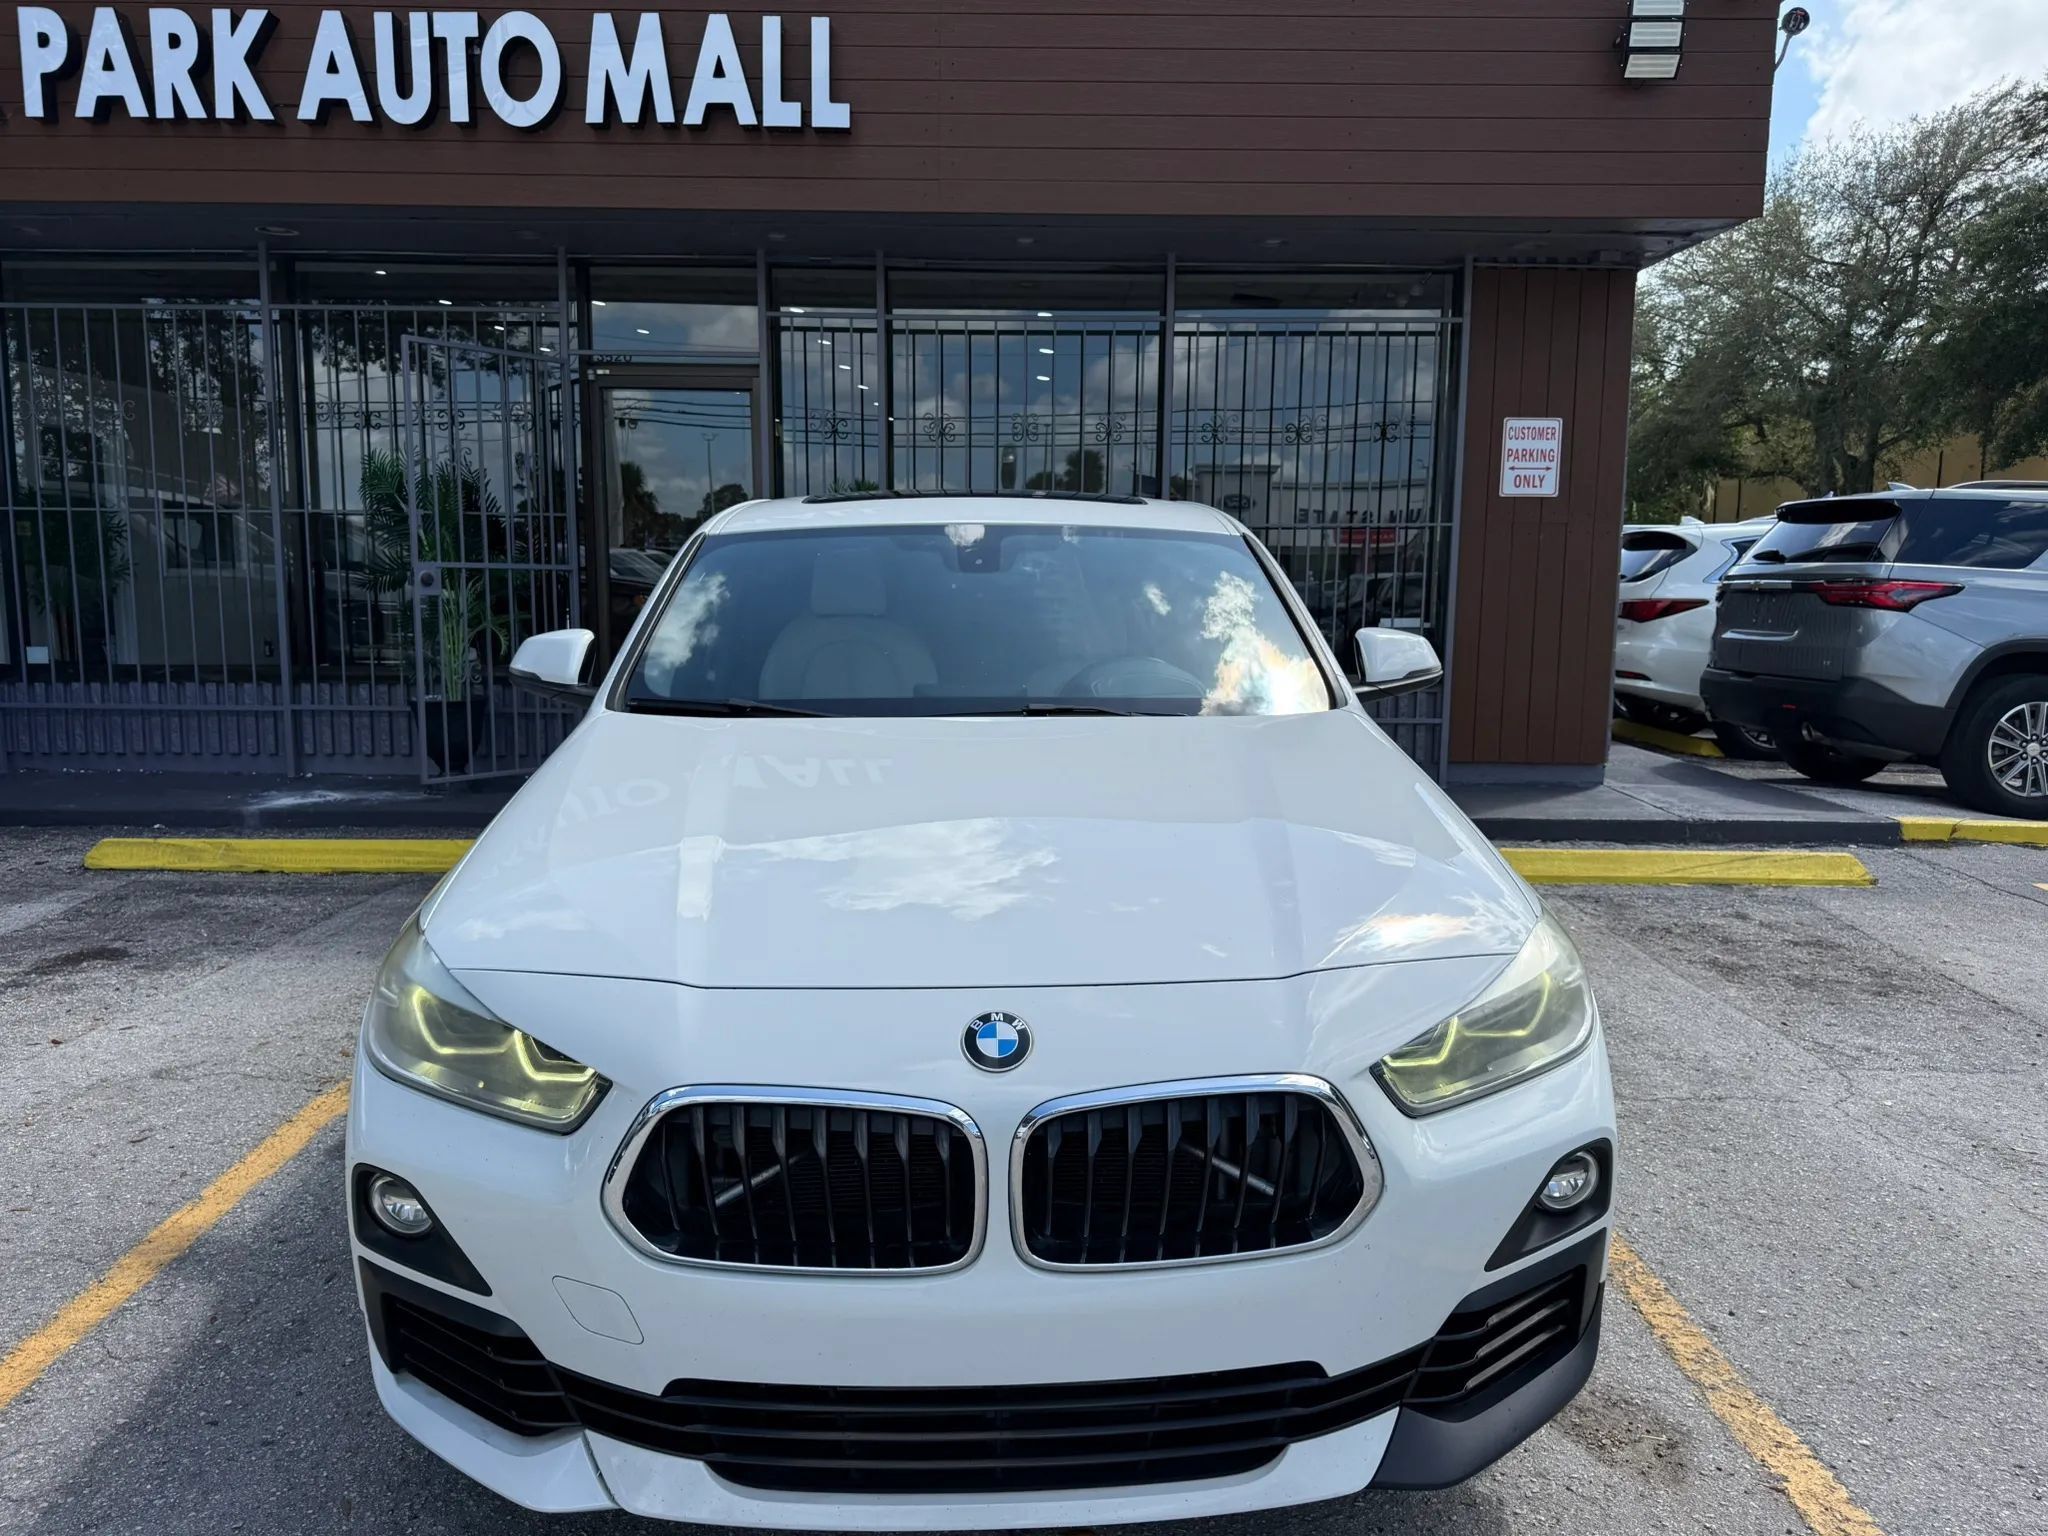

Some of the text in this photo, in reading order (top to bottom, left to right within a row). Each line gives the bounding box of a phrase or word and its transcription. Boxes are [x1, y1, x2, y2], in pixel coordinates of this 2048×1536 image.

[17, 6, 851, 128] PARK AUTO MALL
[1507, 426, 1557, 441] CUSTOMER
[1506, 448, 1555, 463] PARKING
[1513, 474, 1546, 489] ONLY
[970, 1012, 1026, 1031] BMW
